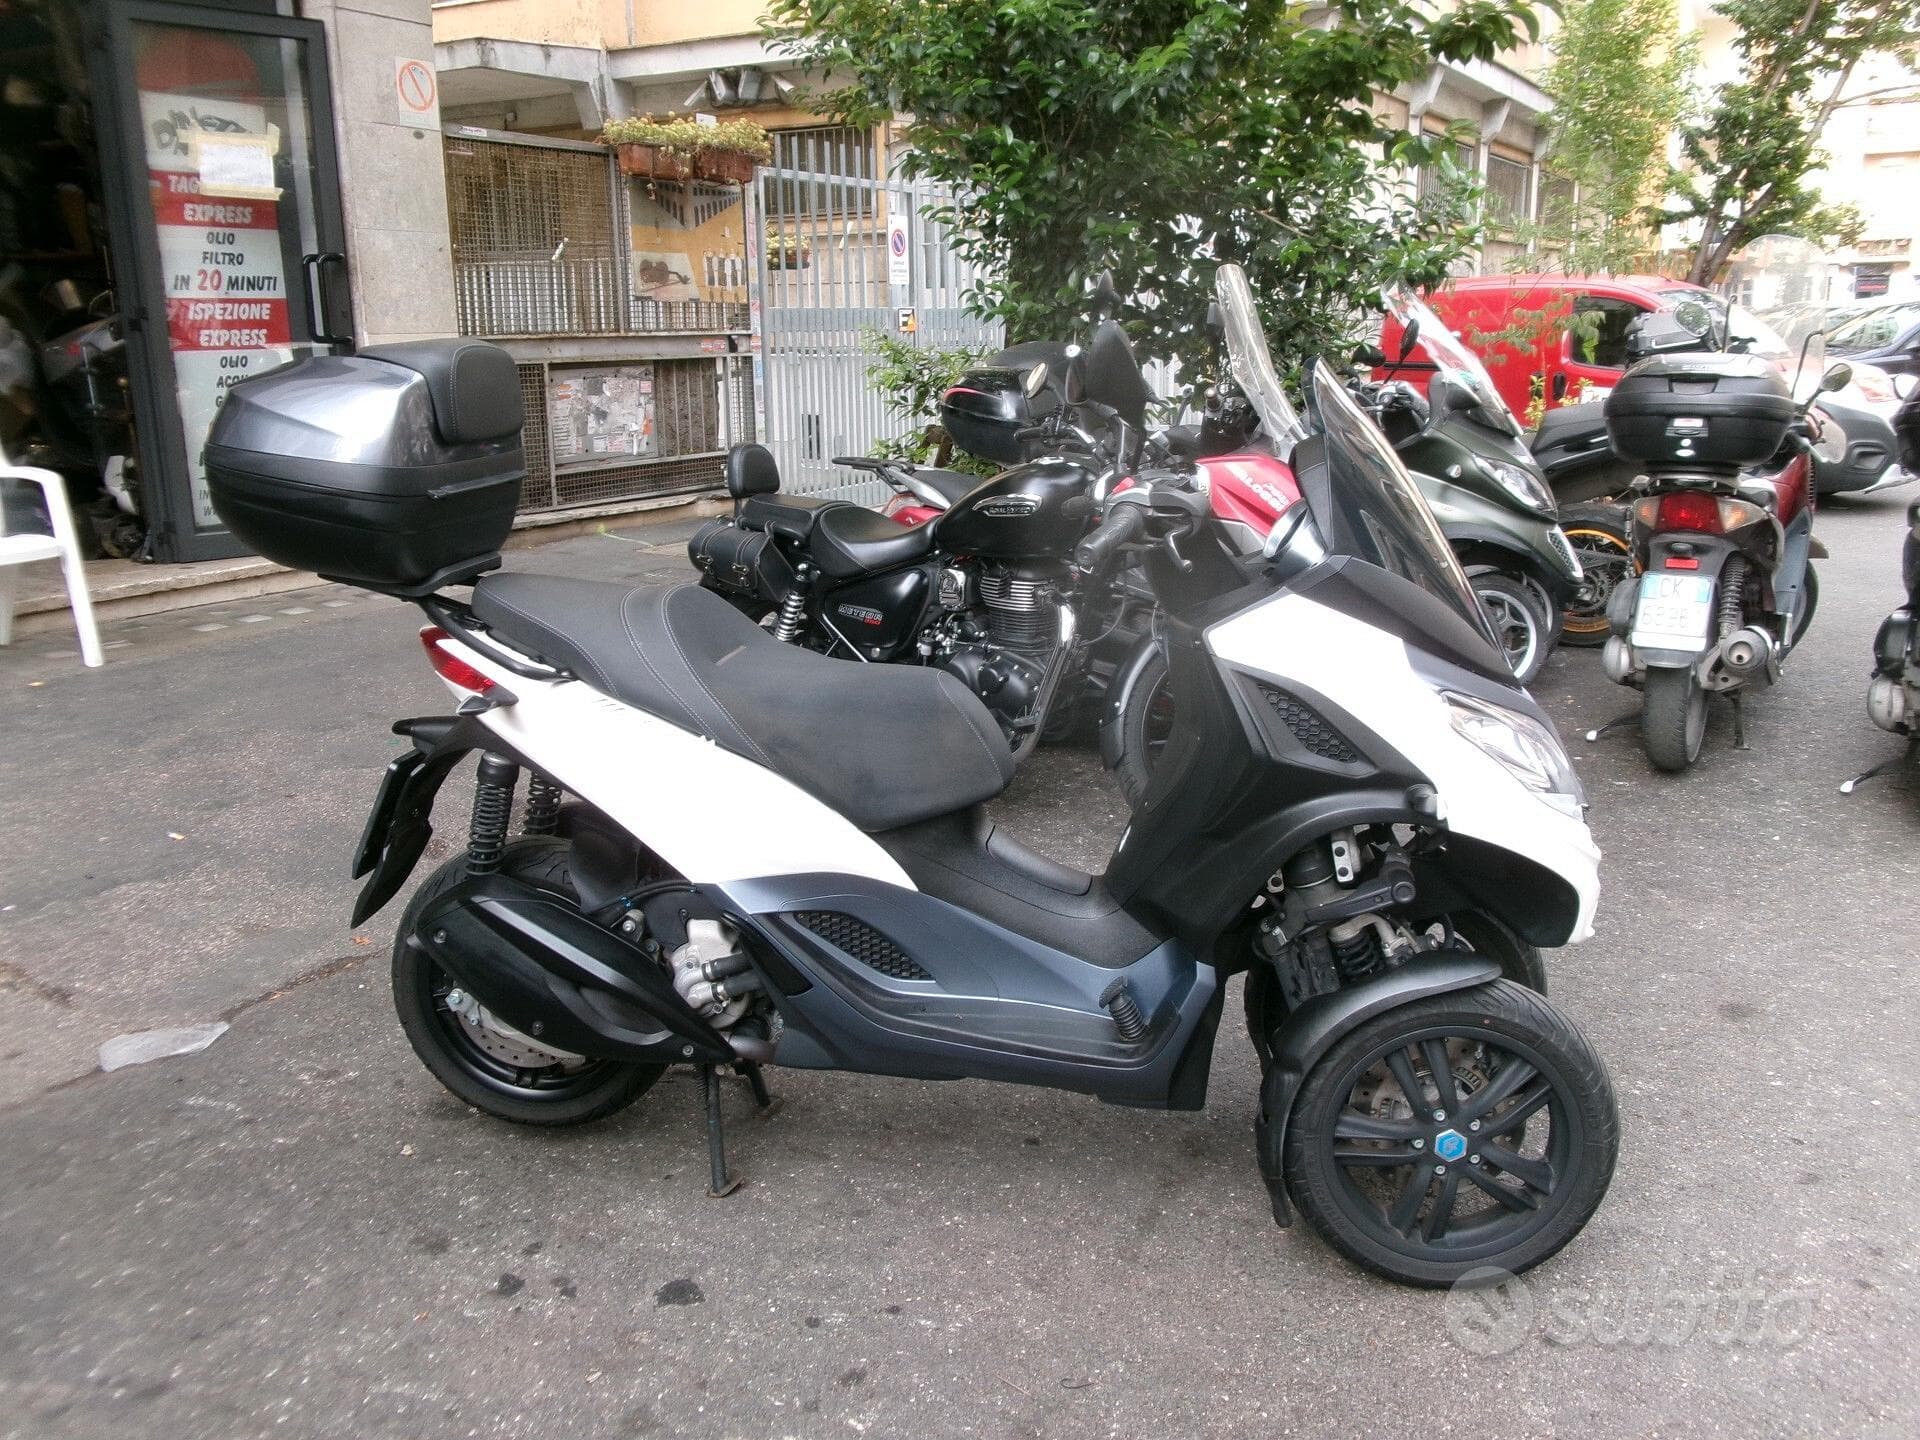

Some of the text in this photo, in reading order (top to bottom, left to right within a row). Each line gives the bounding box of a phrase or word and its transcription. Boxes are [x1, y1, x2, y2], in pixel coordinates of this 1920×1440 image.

[183, 203, 253, 224] EXPRESS
[206, 231, 235, 246] OLIO
[202, 251, 244, 266] FILTRO
[173, 268, 277, 292] IN 20 MINUTI
[188, 302, 271, 321] ISPEZIONE
[199, 328, 268, 347] EXPRESS
[220, 355, 248, 369] OLIO
